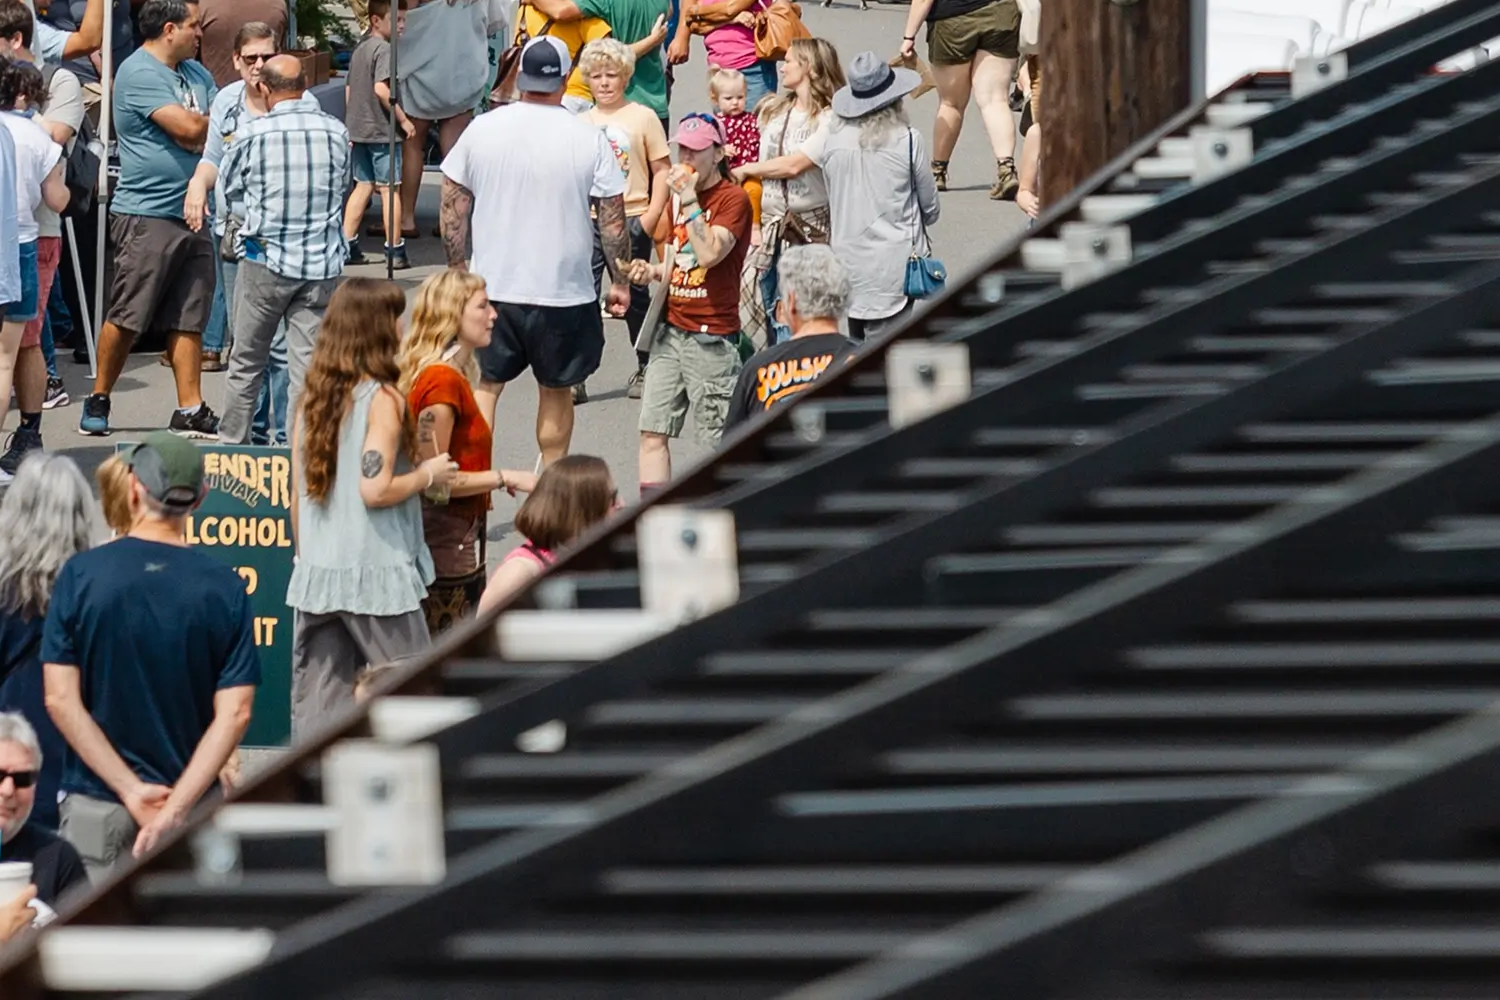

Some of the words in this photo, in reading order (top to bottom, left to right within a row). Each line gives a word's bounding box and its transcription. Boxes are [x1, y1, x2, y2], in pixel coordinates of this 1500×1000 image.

[756, 353, 838, 403] SOULSH
[204, 452, 291, 510] ENDER
[206, 474, 264, 509] IVAL
[183, 516, 291, 548] LCOHOL
